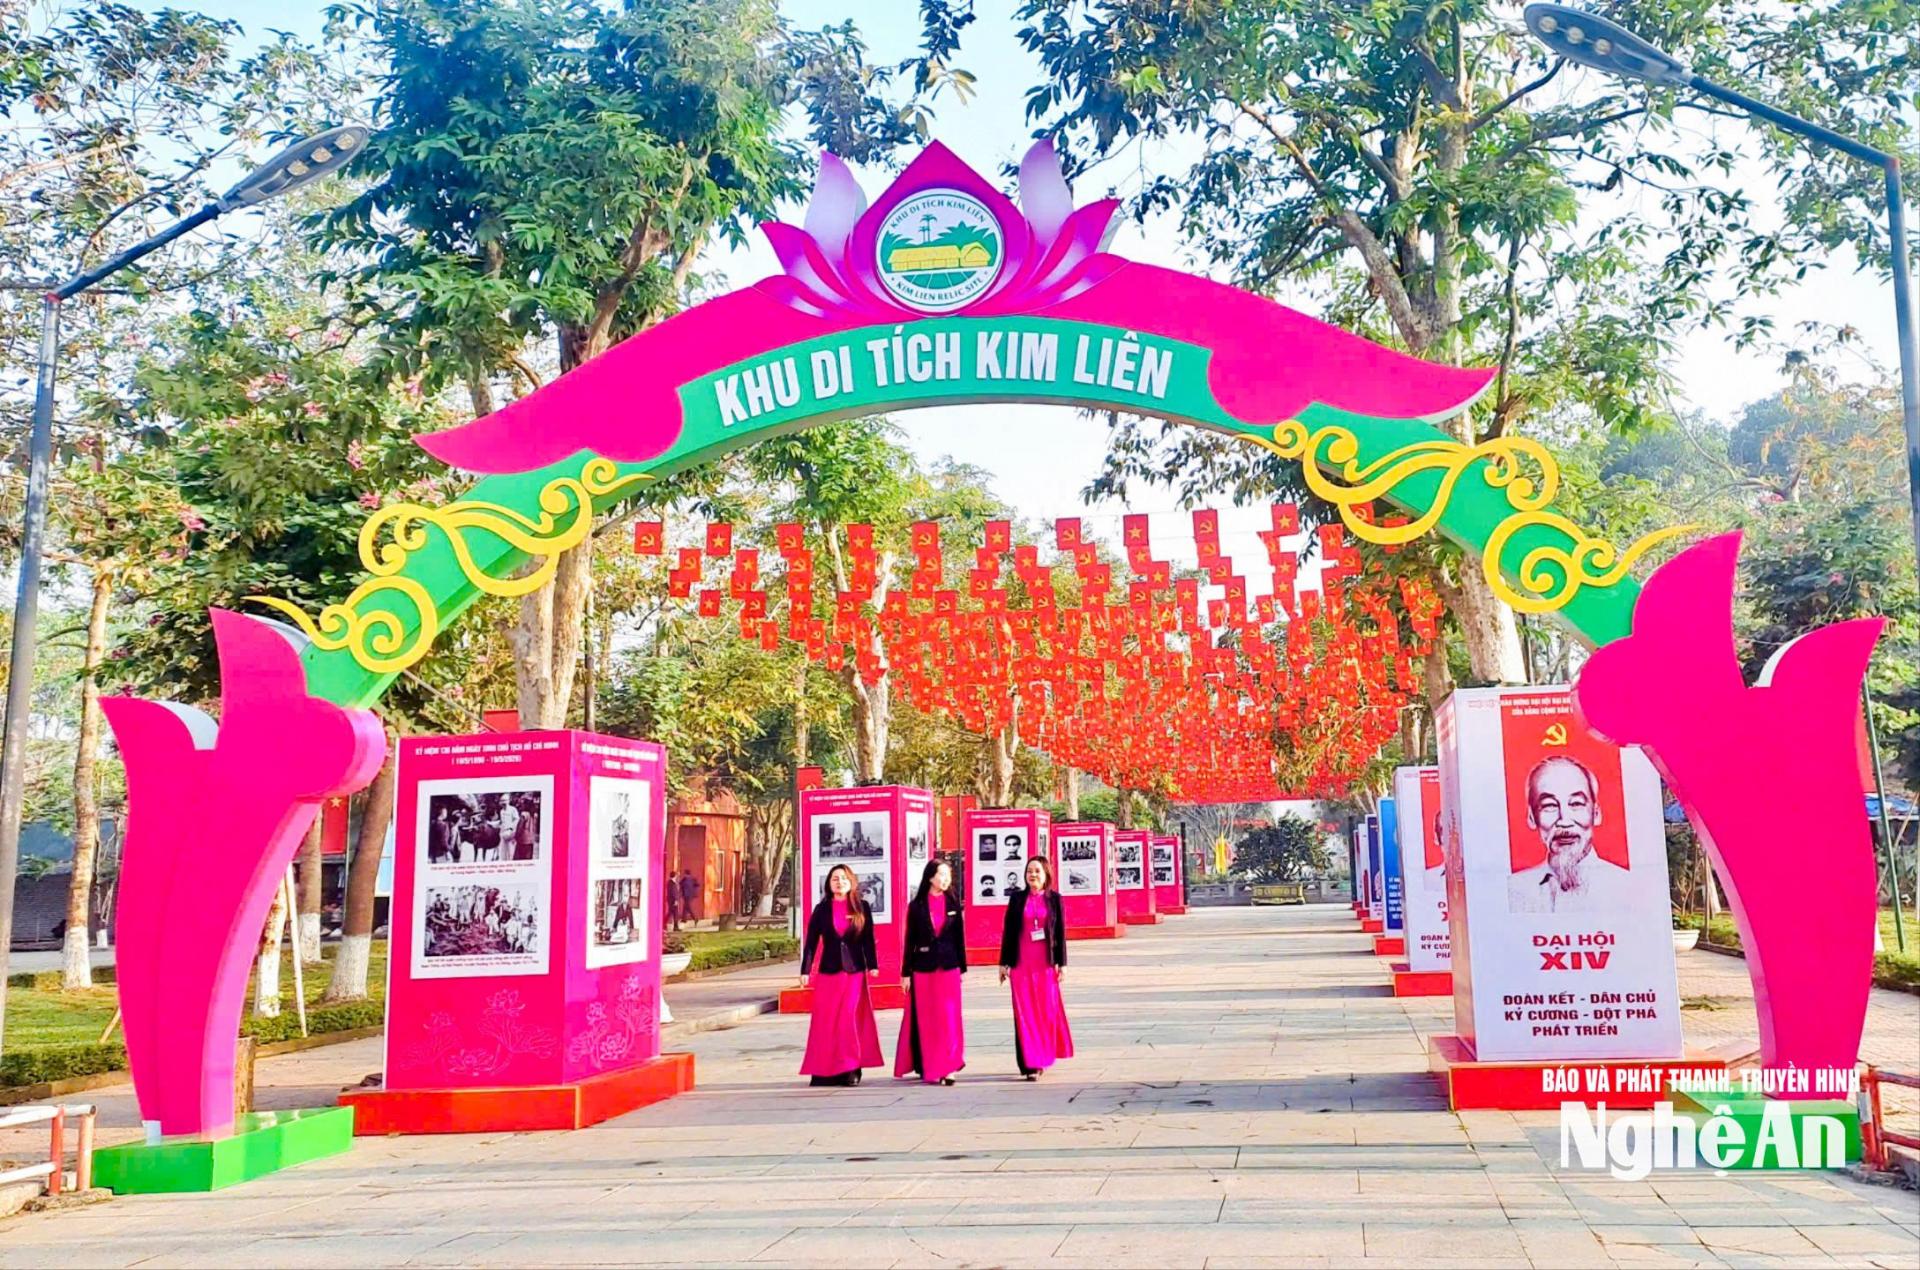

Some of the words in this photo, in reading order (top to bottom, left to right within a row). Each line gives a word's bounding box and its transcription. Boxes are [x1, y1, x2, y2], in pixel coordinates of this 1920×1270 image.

[946, 199, 965, 210] KIM
[896, 281, 913, 296] KIM
[937, 288, 964, 300] RELIC
[713, 356, 801, 427] KHU
[810, 345, 855, 400] DI
[866, 326, 961, 388] TÍCH
[976, 330, 1058, 382] KIM
[1072, 329, 1174, 399] LIÊN
[1532, 934, 1571, 950] ĐẠI
[1578, 930, 1615, 949] HỘI
[1539, 951, 1611, 971] XIV
[1503, 992, 1545, 1005] ĐOÀN
[1548, 990, 1575, 1004] KẾT
[1590, 991, 1621, 1004] DÂN
[1626, 988, 1657, 1003] CHỦ
[1504, 1006, 1523, 1021] KỶ
[1527, 1009, 1579, 1021] CƯƠNG
[1593, 1007, 1622, 1021] ĐỘT
[1626, 1006, 1657, 1019] PHÁ
[1532, 1023, 1571, 1037] PHÁT
[1575, 1021, 1618, 1036] TRIỂN
